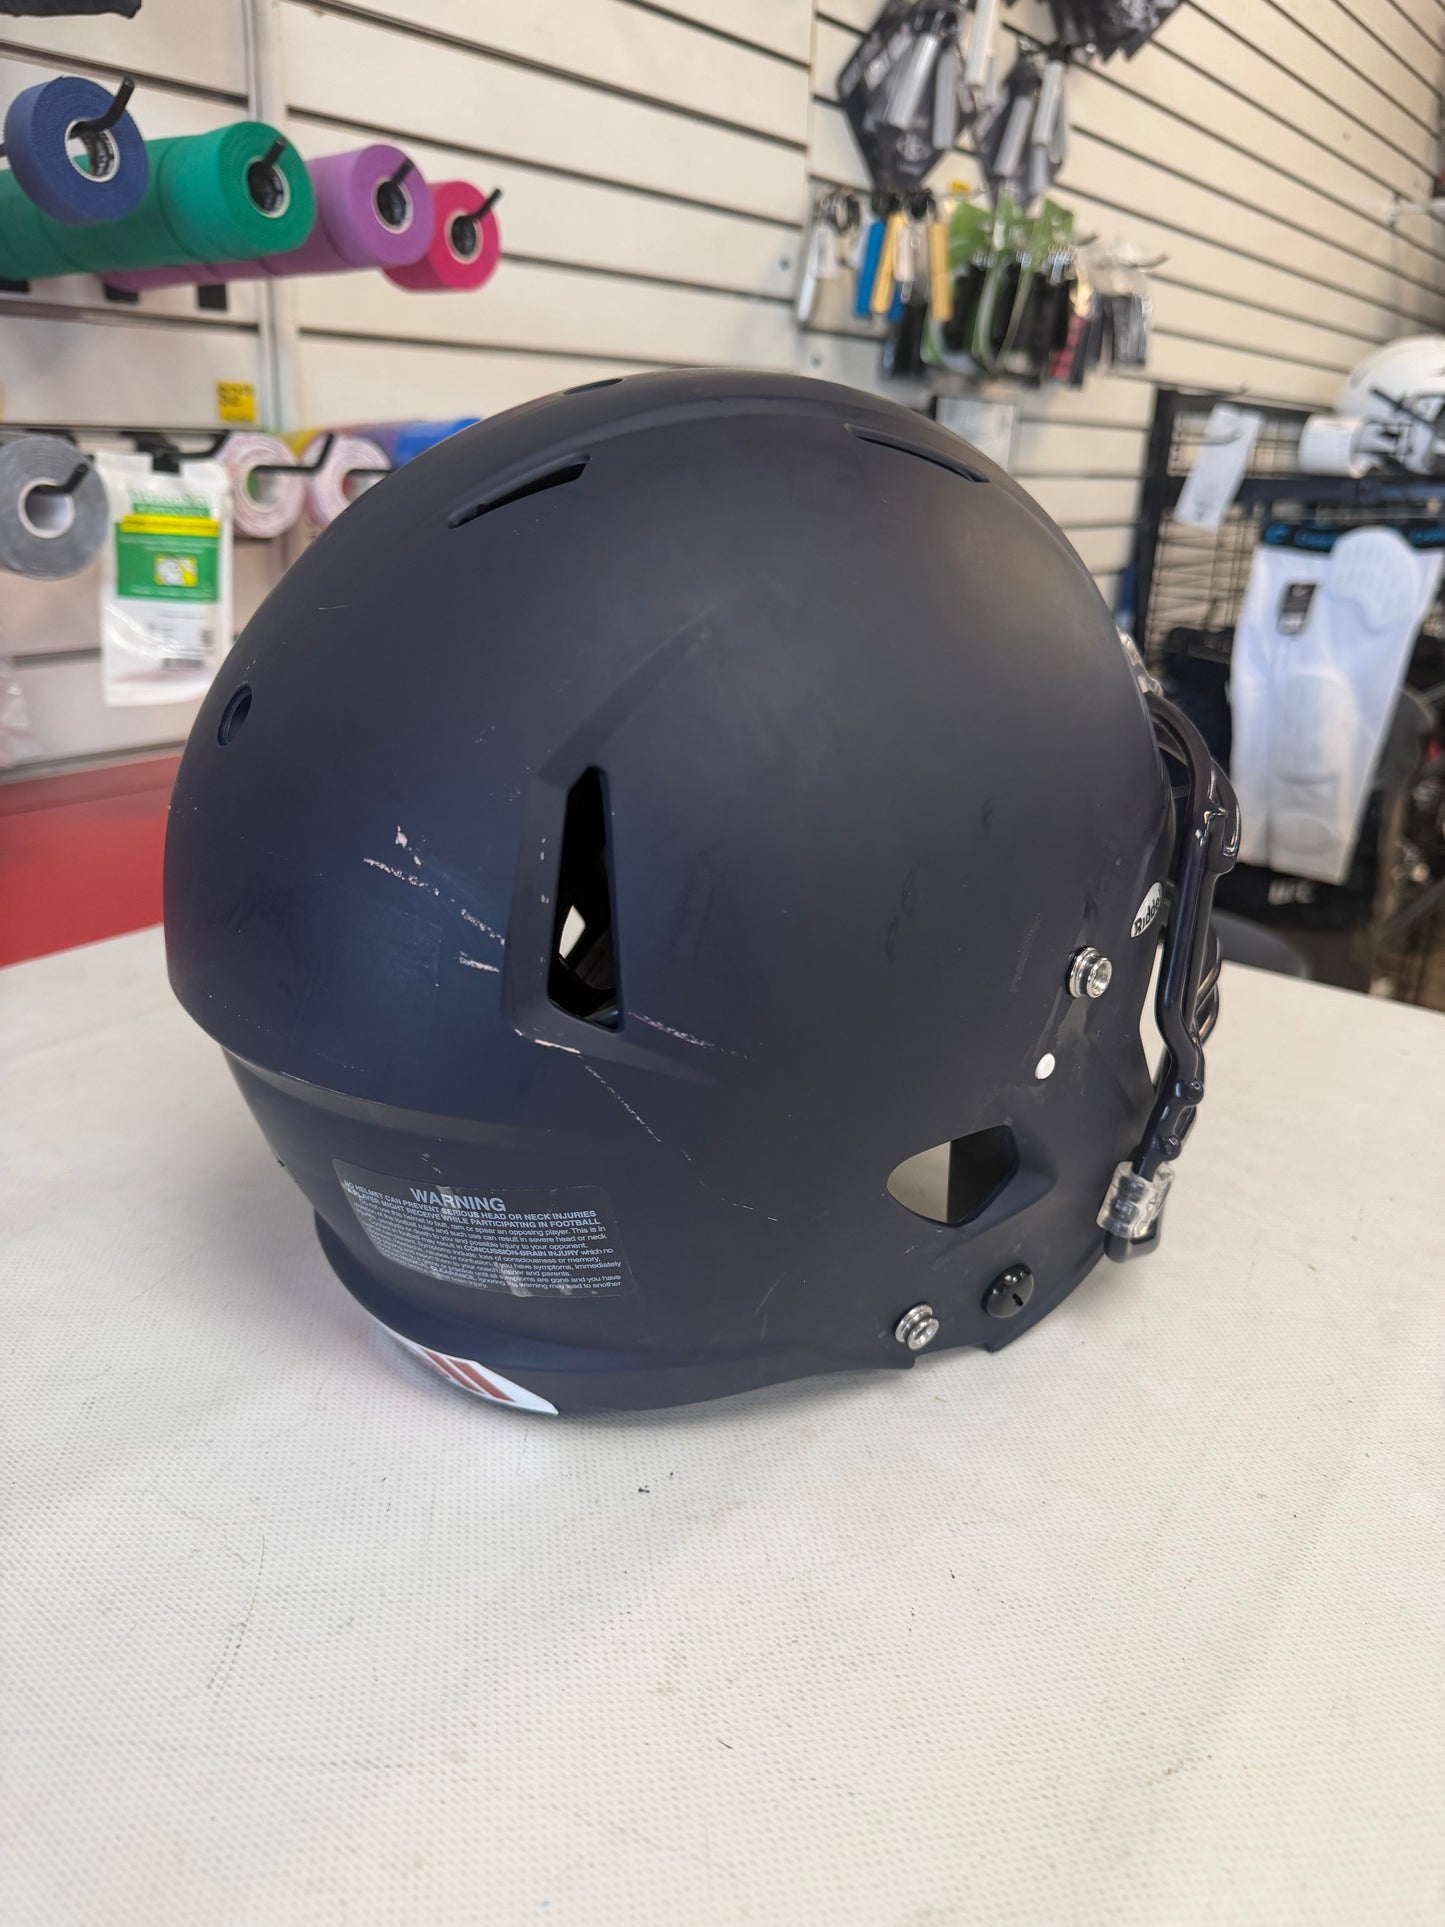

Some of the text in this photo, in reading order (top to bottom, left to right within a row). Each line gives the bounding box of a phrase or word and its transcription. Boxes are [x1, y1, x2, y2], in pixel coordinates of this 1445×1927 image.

[1134, 888, 1162, 935] Ridde
[343, 1180, 355, 1189] NO
[354, 1184, 384, 1200] HELMET
[384, 1195, 402, 1205] CAN
[402, 1199, 440, 1213] PREVENT
[440, 1207, 480, 1219] SERIOUS
[480, 1212, 507, 1220] HEAD
[508, 1213, 523, 1221] OR
[523, 1213, 551, 1221] NECK
[552, 1210, 597, 1220] INJURIES
[408, 1187, 506, 1211] WARNING
[380, 1200, 405, 1212] MIGHT
[406, 1208, 441, 1220] RECEIVE
[440, 1214, 469, 1225] WHILE
[470, 1218, 537, 1228] PARTICIPATING
[549, 1218, 601, 1228] FOOTBALL
[508, 1229, 544, 1237] opposing
[544, 1228, 571, 1236] player.
[499, 1242, 520, 1250] injury
[547, 1249, 579, 1257] INJURY
[575, 1261, 622, 1270] immediately
